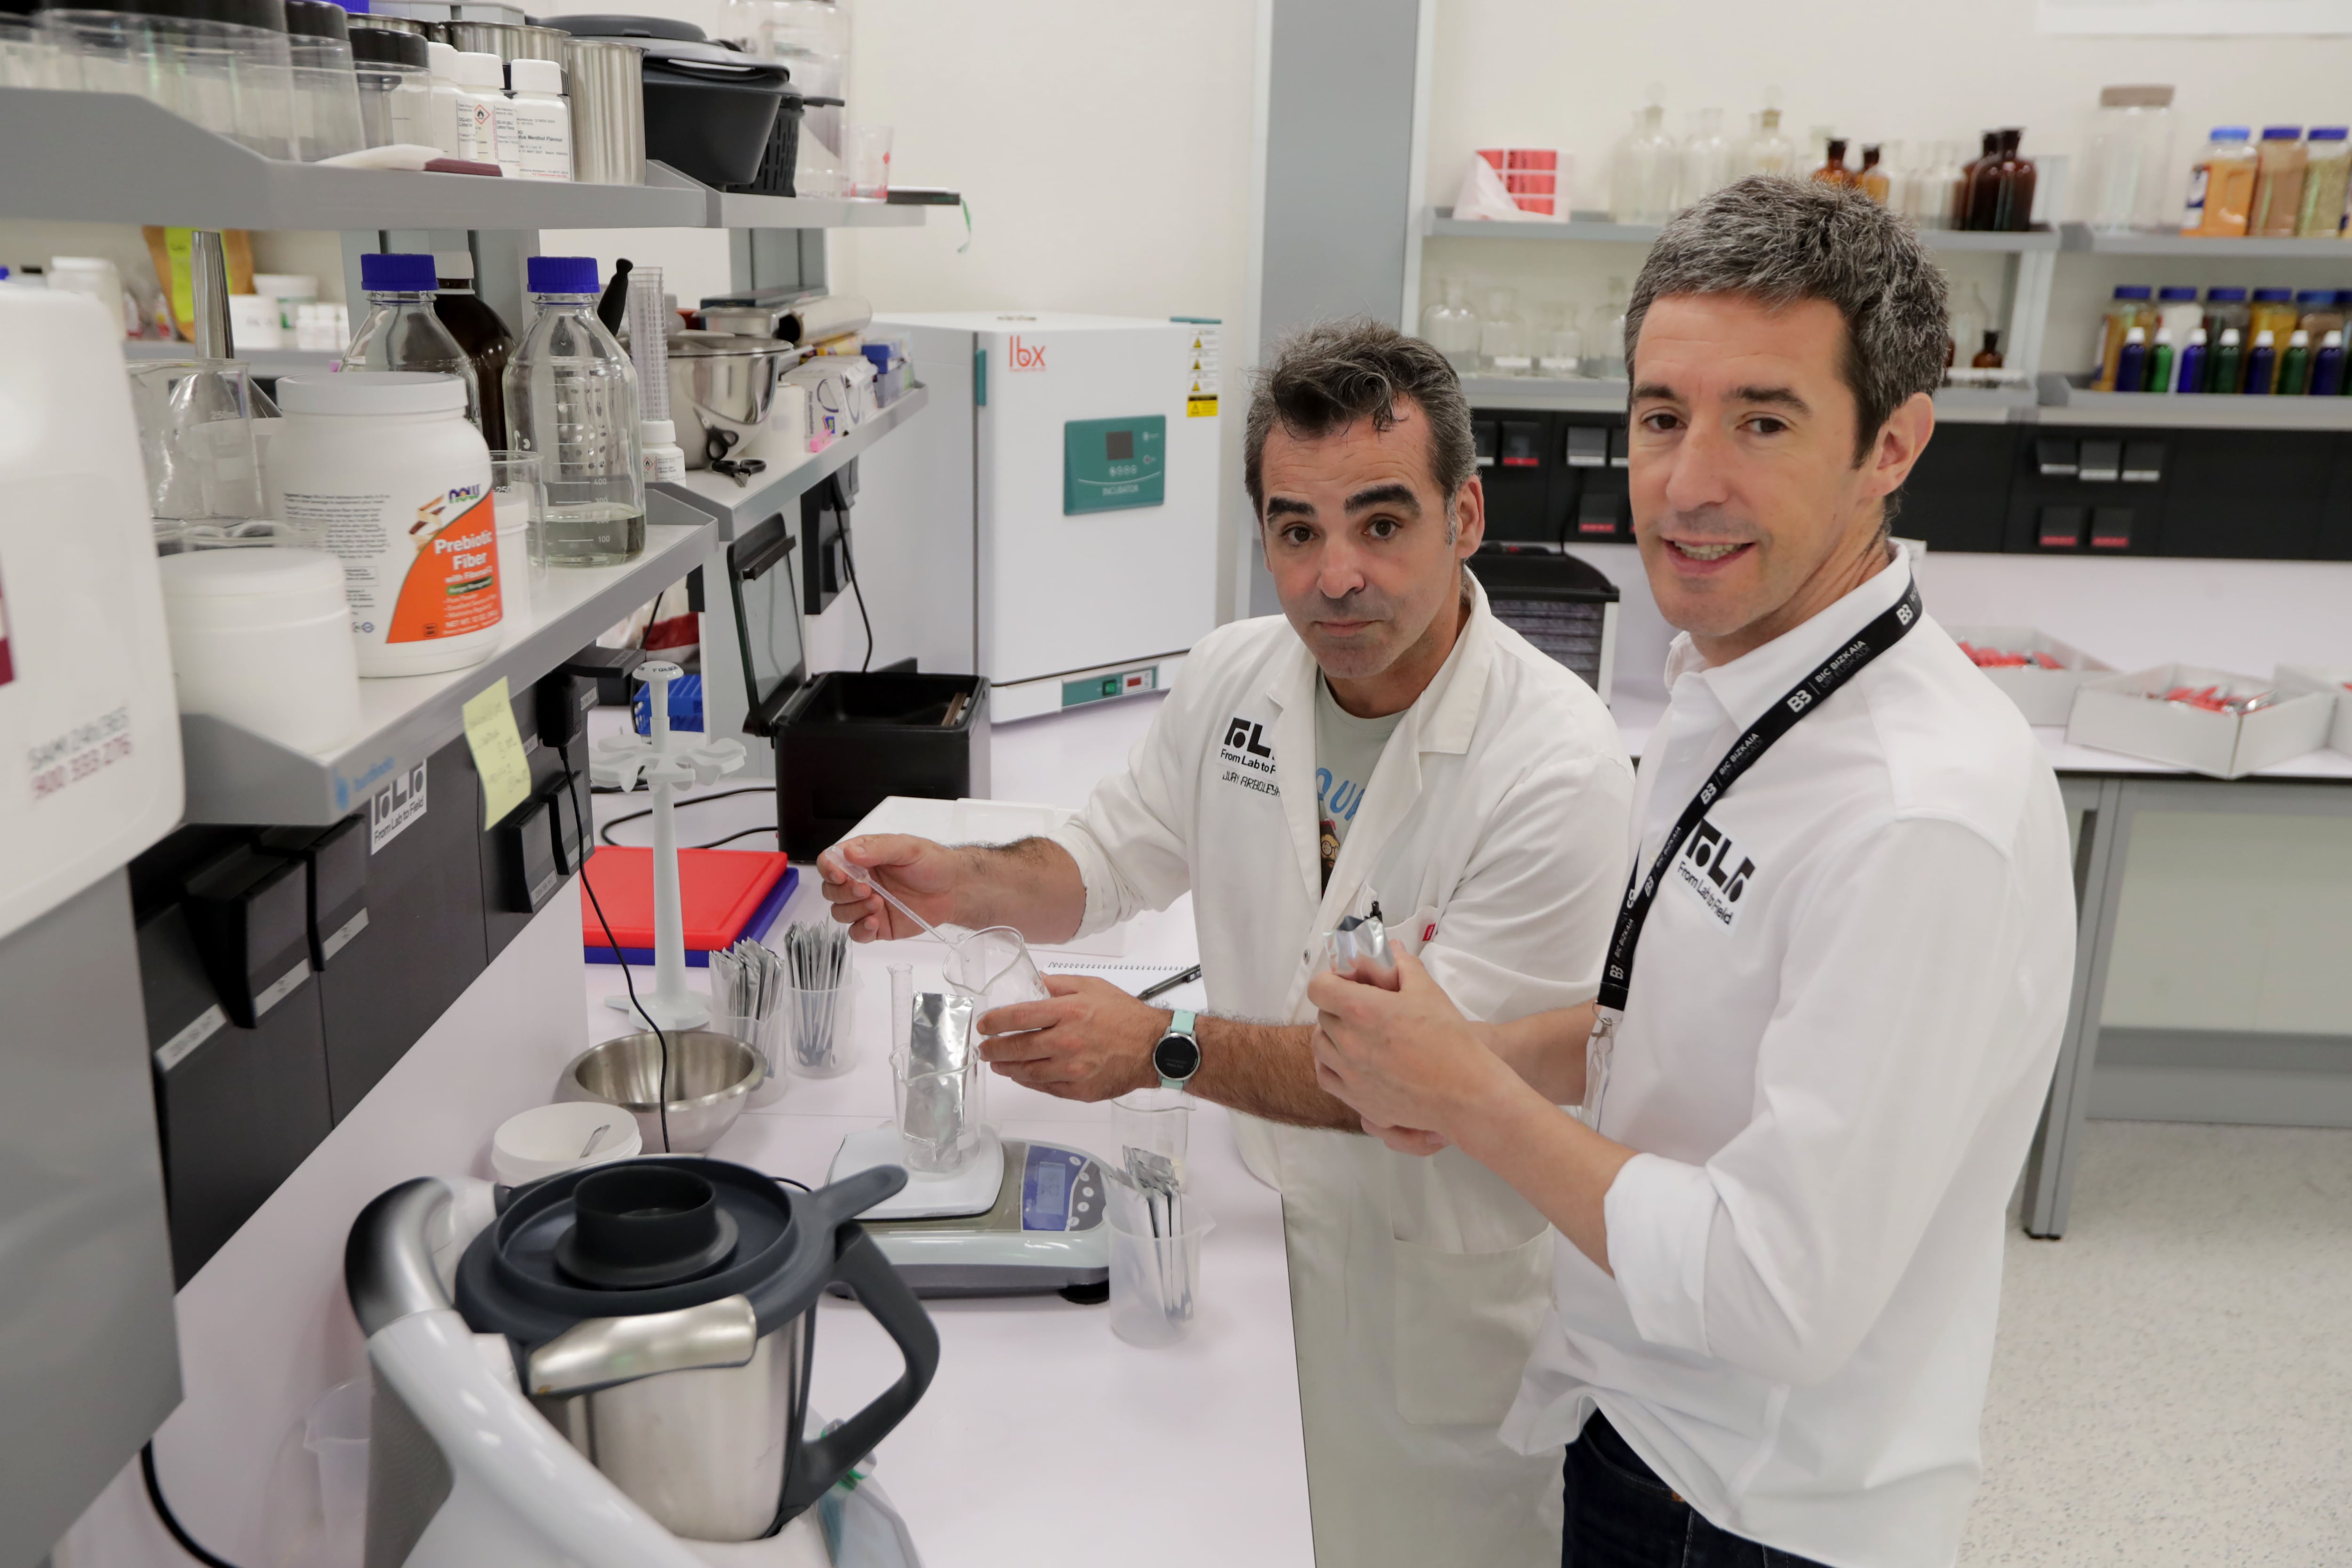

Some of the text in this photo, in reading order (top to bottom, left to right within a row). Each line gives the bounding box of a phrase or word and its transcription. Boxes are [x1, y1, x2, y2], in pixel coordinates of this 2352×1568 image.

[434, 530, 493, 554] Prebiotic
[453, 552, 487, 570] Fiber
[1814, 668, 1832, 683] BIC
[1829, 640, 1867, 670] BIZKAIA
[1221, 749, 1240, 763] From
[1241, 755, 1260, 770] Lab
[1261, 761, 1270, 773] to
[1719, 760, 1732, 775] BIC
[1729, 733, 1760, 762] BIZKAIA
[374, 795, 423, 844] From Lab to Field
[1677, 860, 1734, 926] From Lab to Field
[1614, 944, 1622, 958] BIC
[1618, 918, 1634, 947] BIZKAIA
